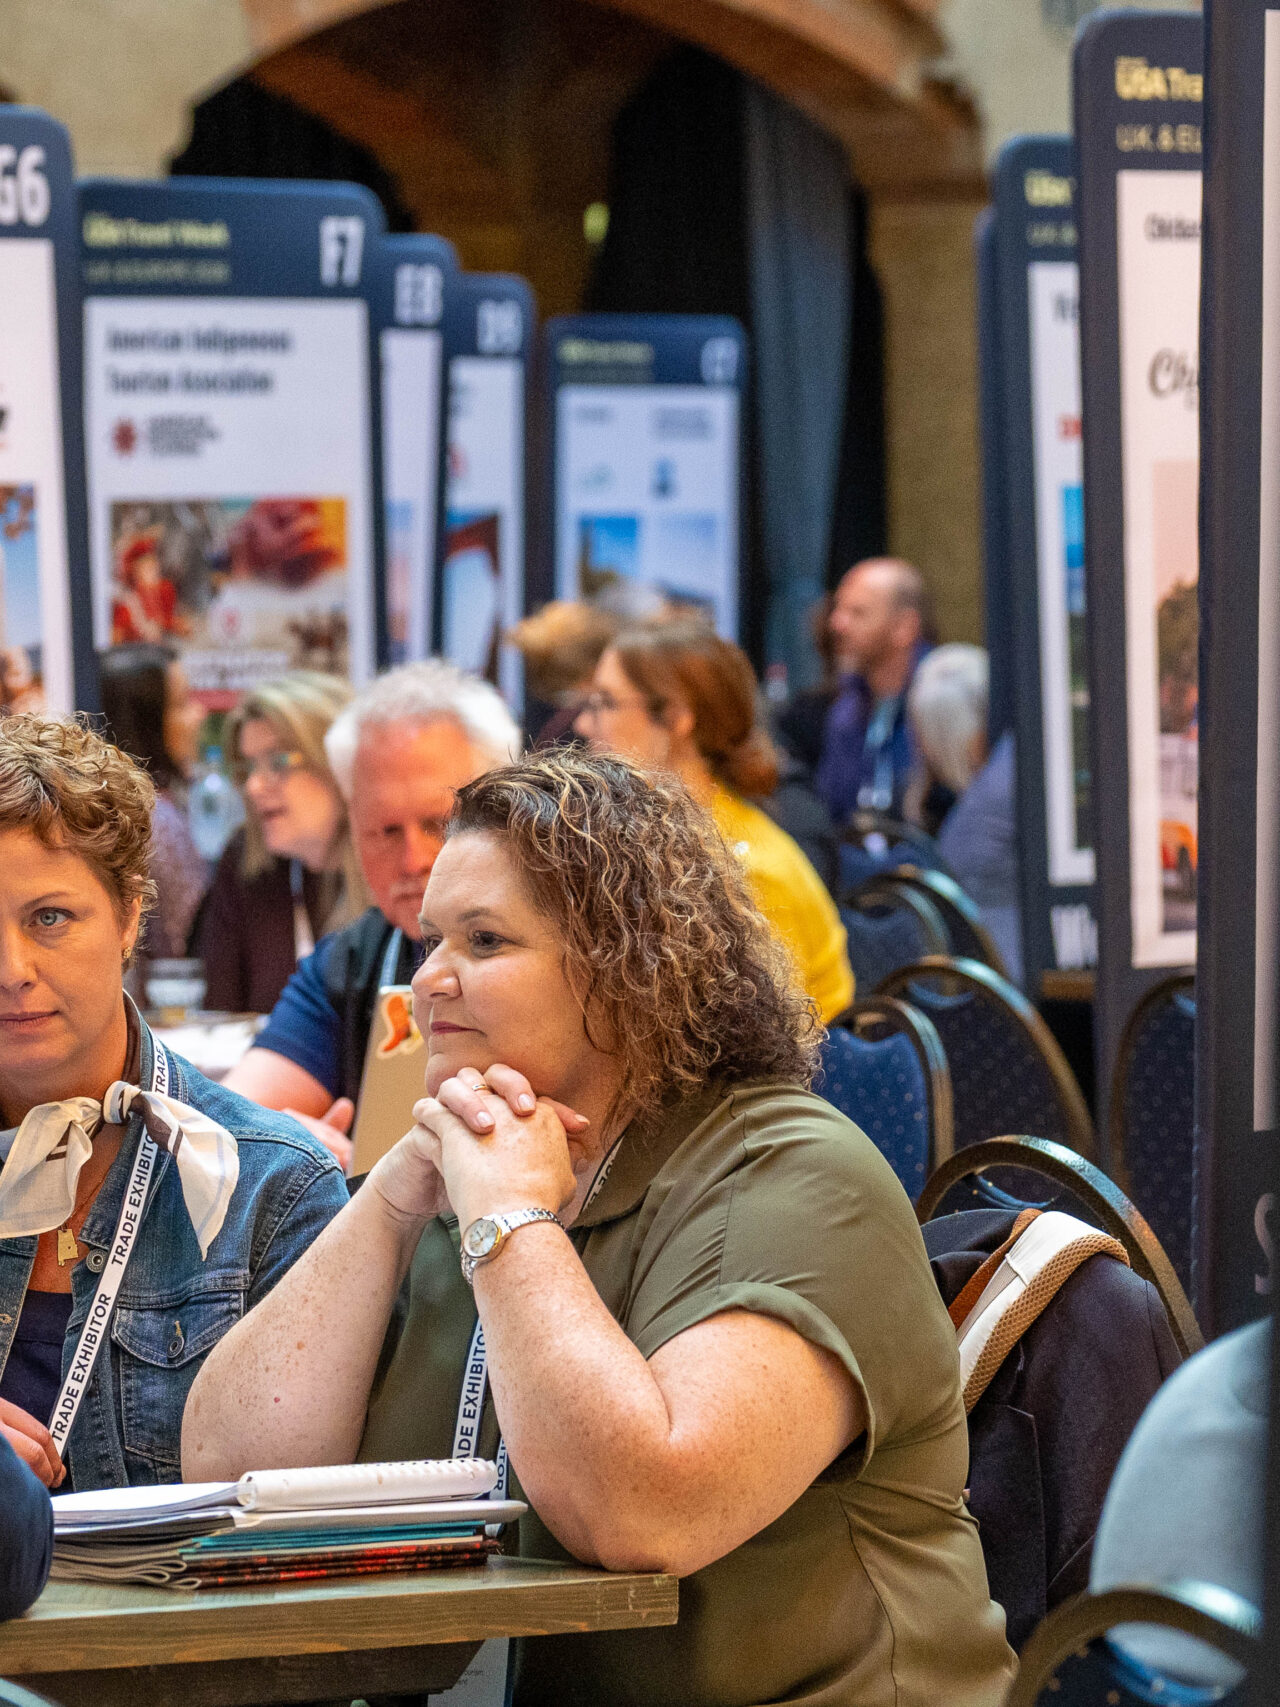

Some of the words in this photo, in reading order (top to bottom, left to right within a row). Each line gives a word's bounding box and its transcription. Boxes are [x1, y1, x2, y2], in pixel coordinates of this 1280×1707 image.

[320, 216, 364, 287] F7
[155, 1045, 168, 1094] TRADE
[111, 1211, 138, 1267] TRADE
[52, 1389, 80, 1443] TRADE
[75, 1293, 111, 1384] EXHIBITOR
